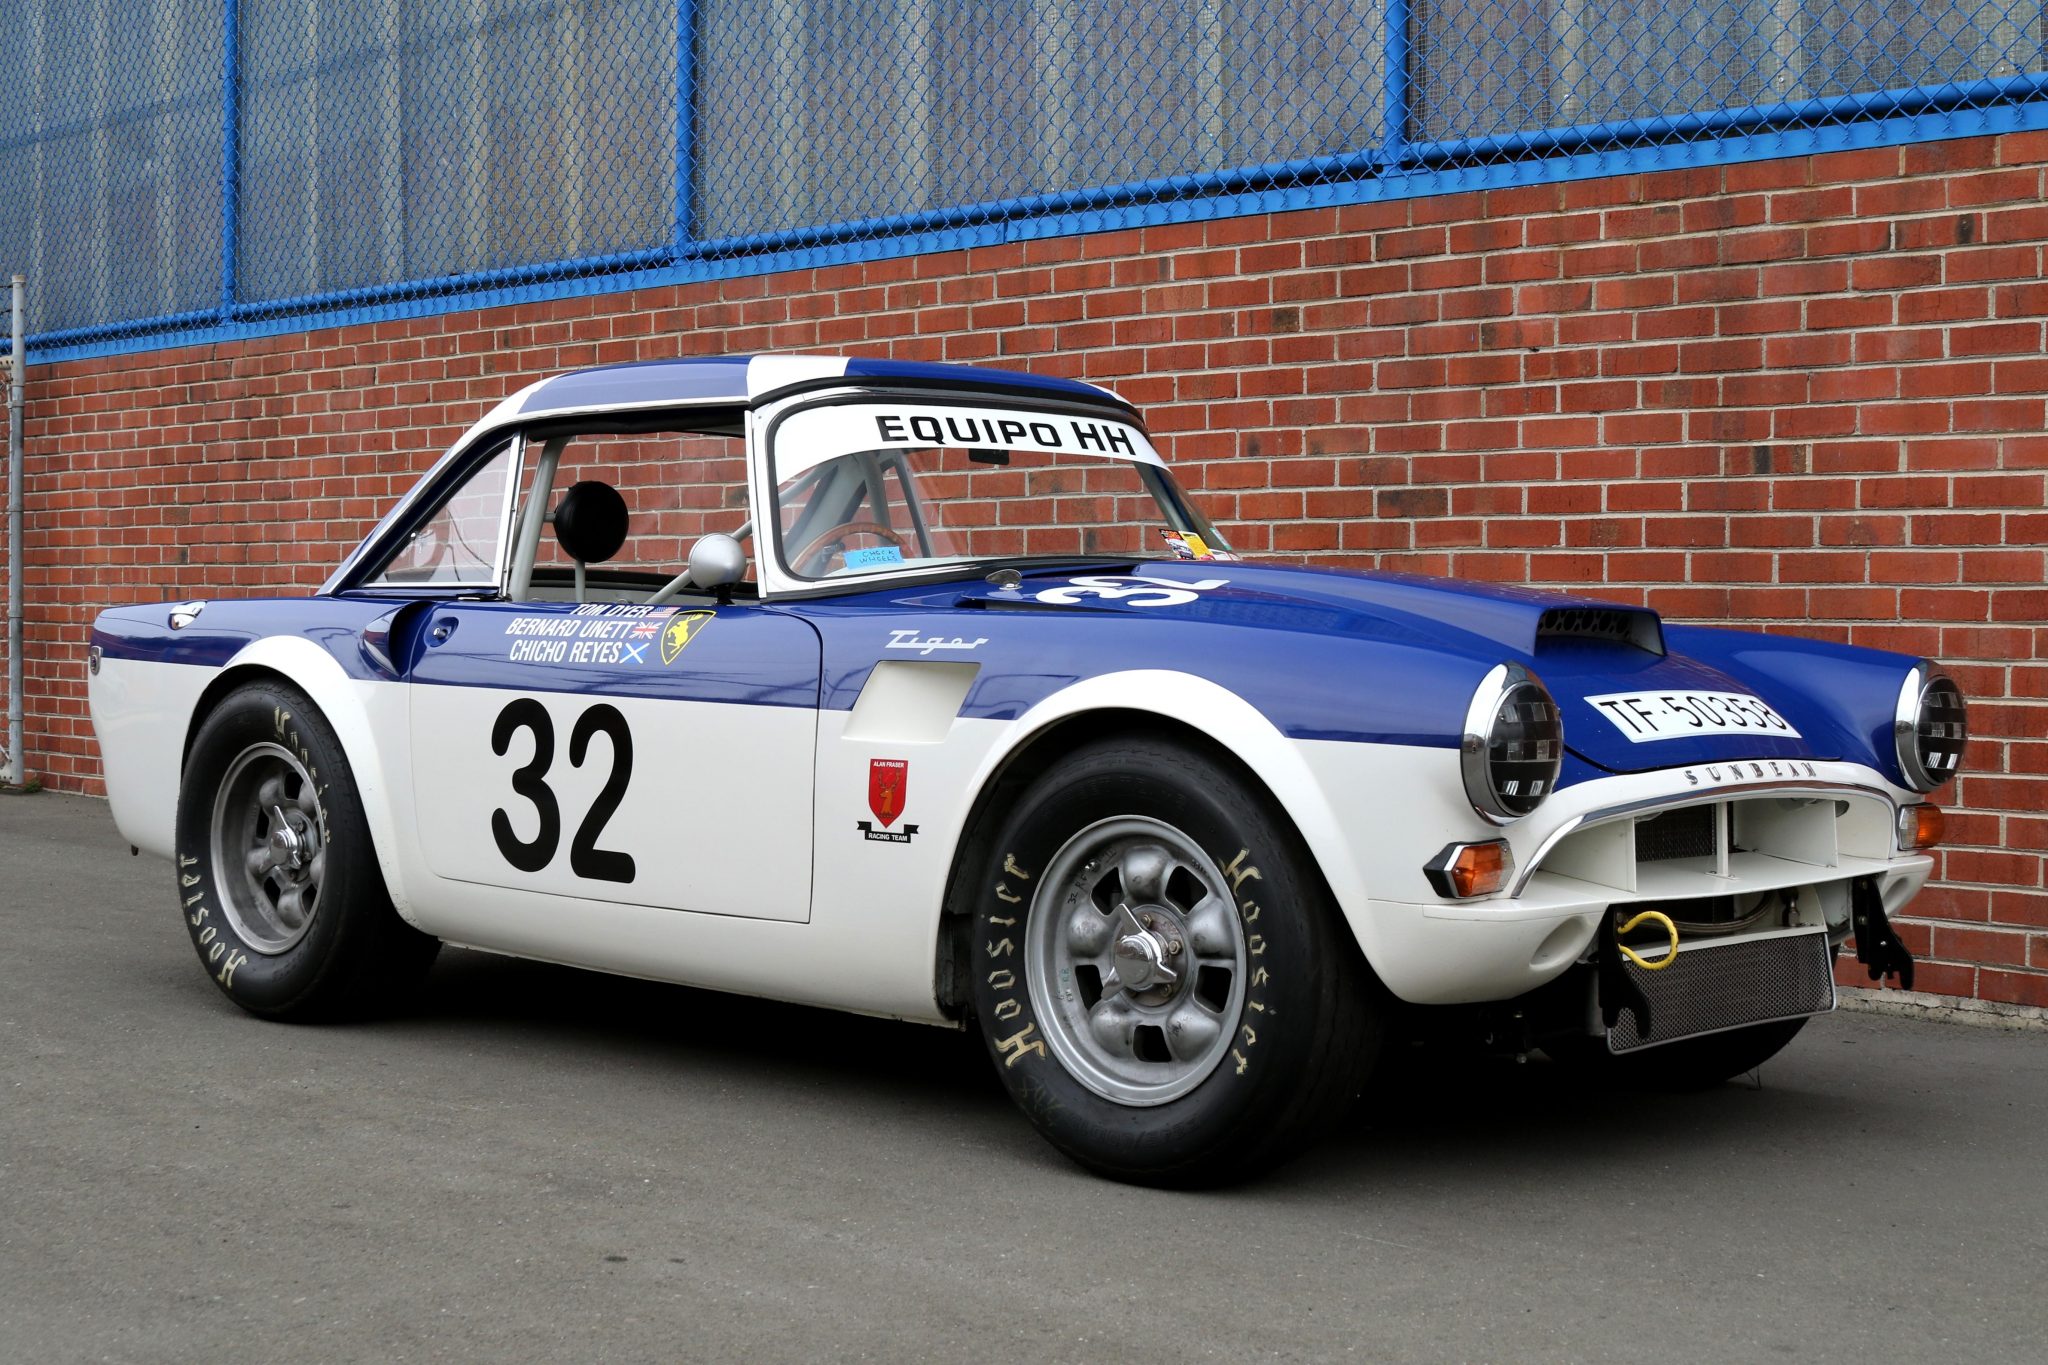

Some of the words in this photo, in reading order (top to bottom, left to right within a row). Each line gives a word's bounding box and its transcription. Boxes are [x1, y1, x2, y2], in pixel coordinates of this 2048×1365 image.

[876, 415, 1062, 448] EQUIPO
[1070, 422, 1136, 456] HH
[570, 604, 608, 616] TOM
[608, 604, 654, 618] DYER
[505, 618, 579, 638] BERNARD
[580, 620, 635, 638] UNETT
[509, 639, 567, 662] CHICHO
[568, 641, 621, 663] REYES
[885, 630, 989, 655] Tiger
[1684, 761, 1817, 785] SUNBEAM
[491, 697, 636, 884] 32
